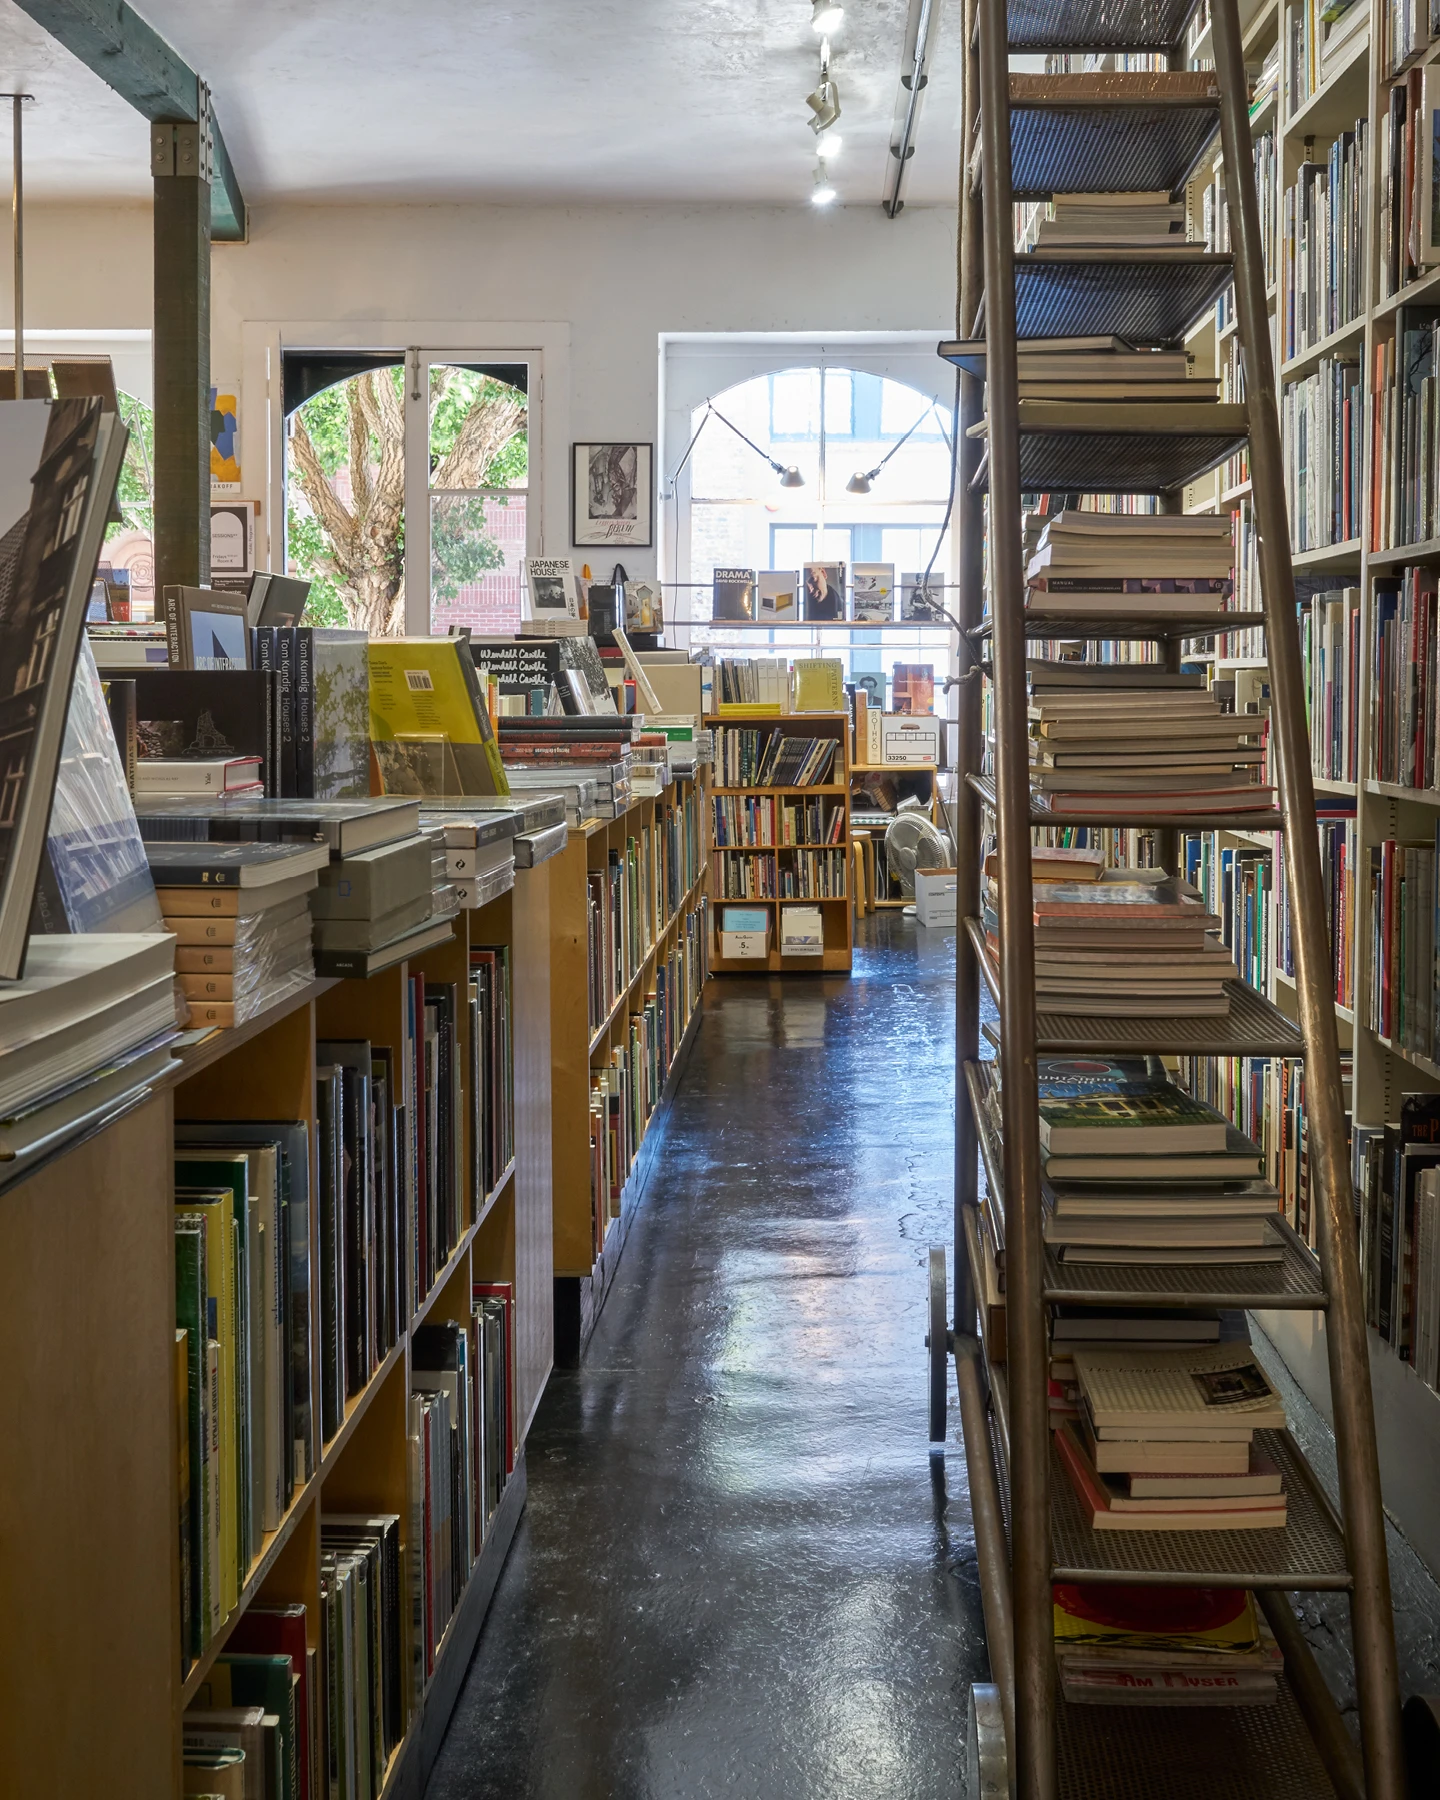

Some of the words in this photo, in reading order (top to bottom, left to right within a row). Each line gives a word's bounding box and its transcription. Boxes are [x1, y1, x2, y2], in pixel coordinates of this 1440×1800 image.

[530, 568, 557, 576] HOUSE
[715, 570, 750, 579] DRAMA
[167, 598, 175, 612] ARC
[169, 612, 177, 622] OF
[170, 622, 179, 663] INTERACTION
[260, 638, 270, 657] Tom
[280, 638, 289, 658] Tom
[299, 638, 309, 658] Tom
[480, 649, 518, 659] Wendell
[518, 649, 547, 659] Castle
[518, 661, 547, 671] Castle
[281, 660, 290, 693] Kundig
[298, 660, 310, 693] Kundig
[497, 673, 518, 683] ndell
[282, 697, 291, 733] Houses
[301, 697, 309, 733] Houses
[1412, 1124, 1428, 1137] THE
